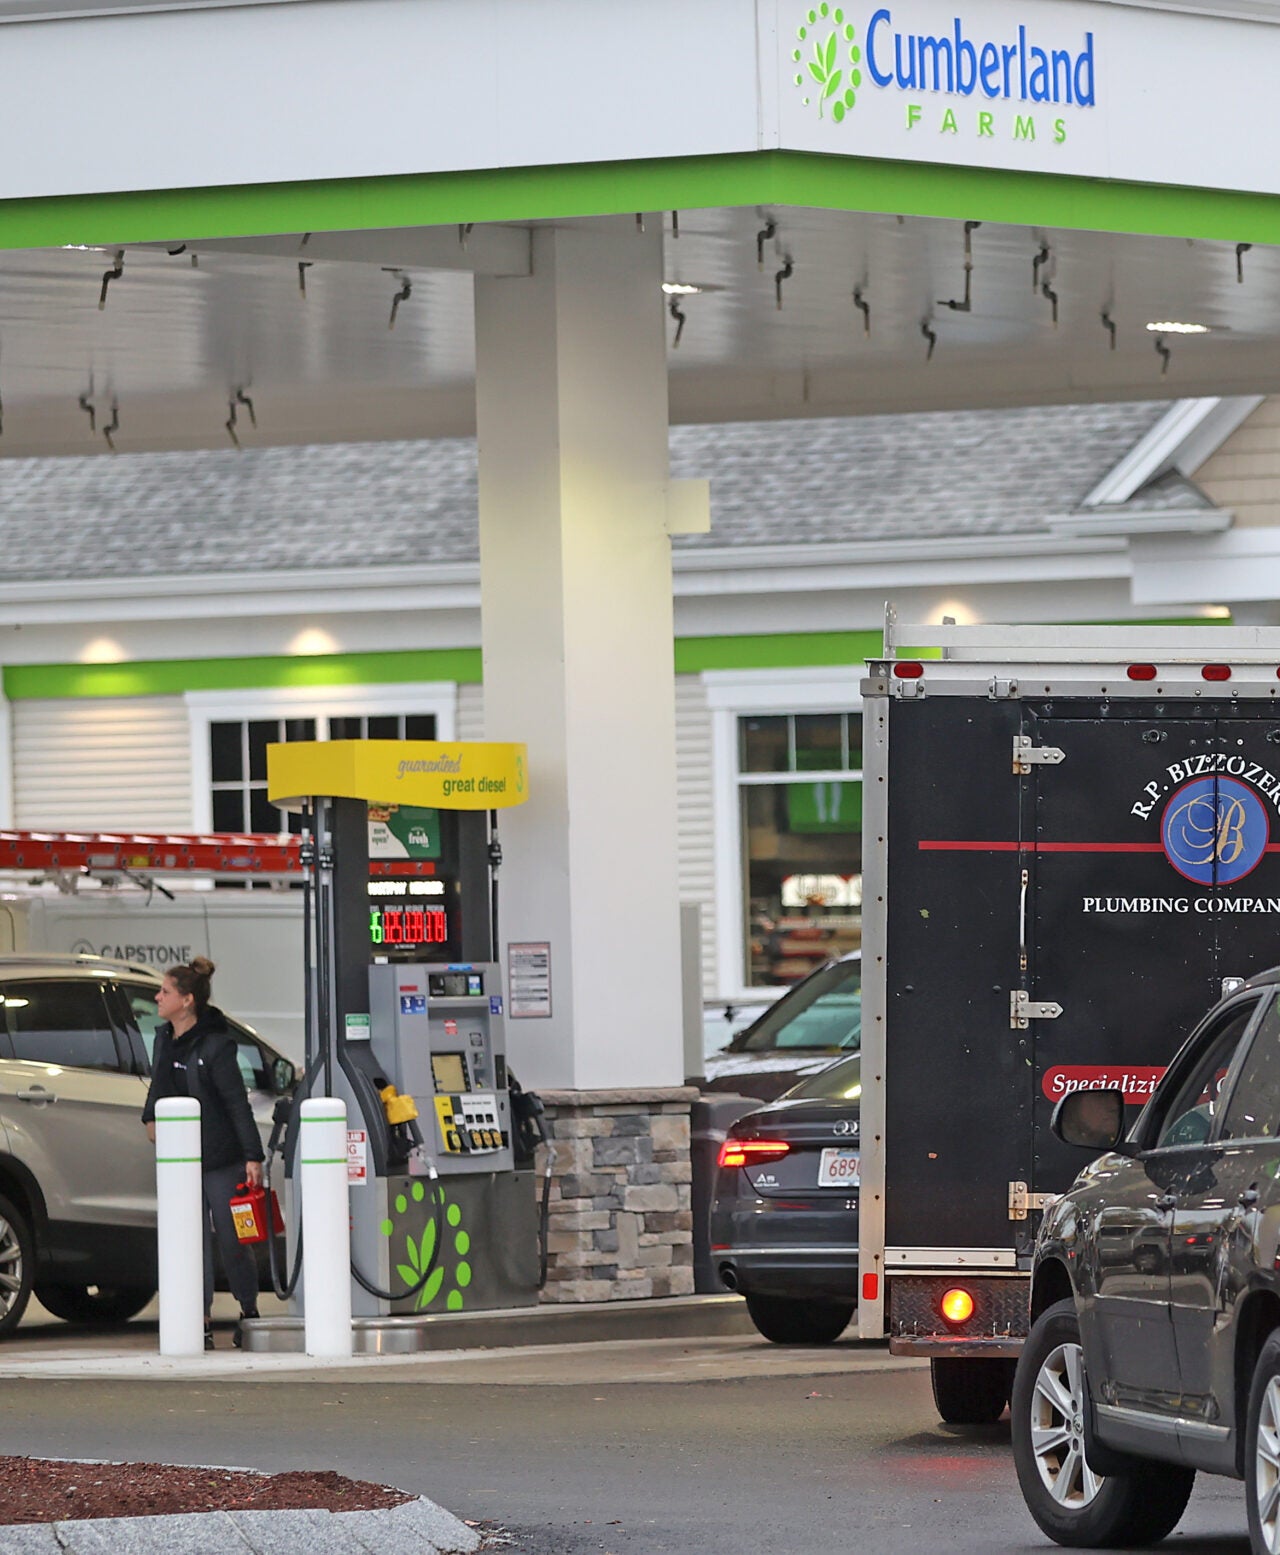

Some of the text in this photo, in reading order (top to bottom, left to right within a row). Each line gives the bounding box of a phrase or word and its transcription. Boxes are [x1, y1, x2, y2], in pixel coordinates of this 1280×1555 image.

[866, 9, 1096, 108] Cumberland
[905, 104, 1067, 144] FARMS
[443, 776, 506, 796] great diesel
[1131, 780, 1169, 820] R.P.
[1083, 897, 1189, 914] PLUMBING
[101, 945, 191, 963] CAPSTONE
[1052, 1073, 1161, 1096] Specializi
